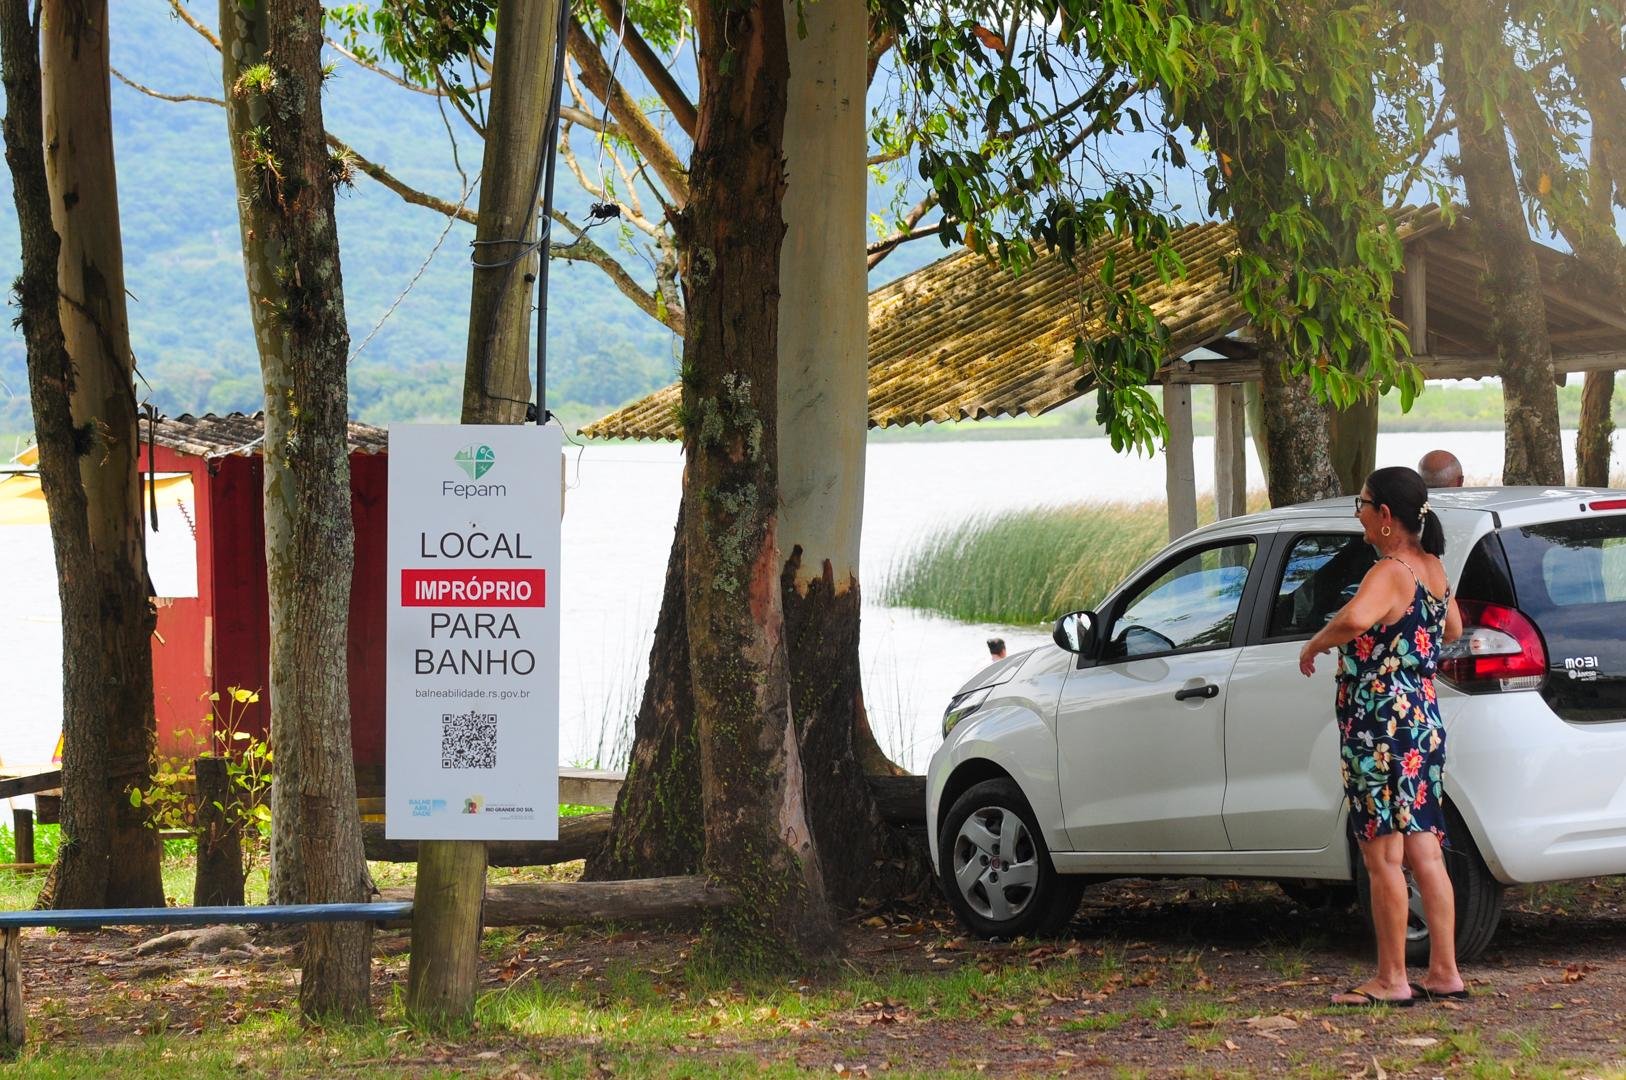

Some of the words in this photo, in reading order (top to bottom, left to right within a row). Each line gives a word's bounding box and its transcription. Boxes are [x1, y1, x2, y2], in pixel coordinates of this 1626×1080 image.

[442, 481, 507, 499] Fepam
[421, 532, 532, 559] LOCAL
[415, 576, 532, 601] IMPRÓPRIO
[431, 613, 521, 639] PARA
[415, 649, 536, 676] BANHO
[415, 688, 531, 700] balneabilidade.rs.gov.br
